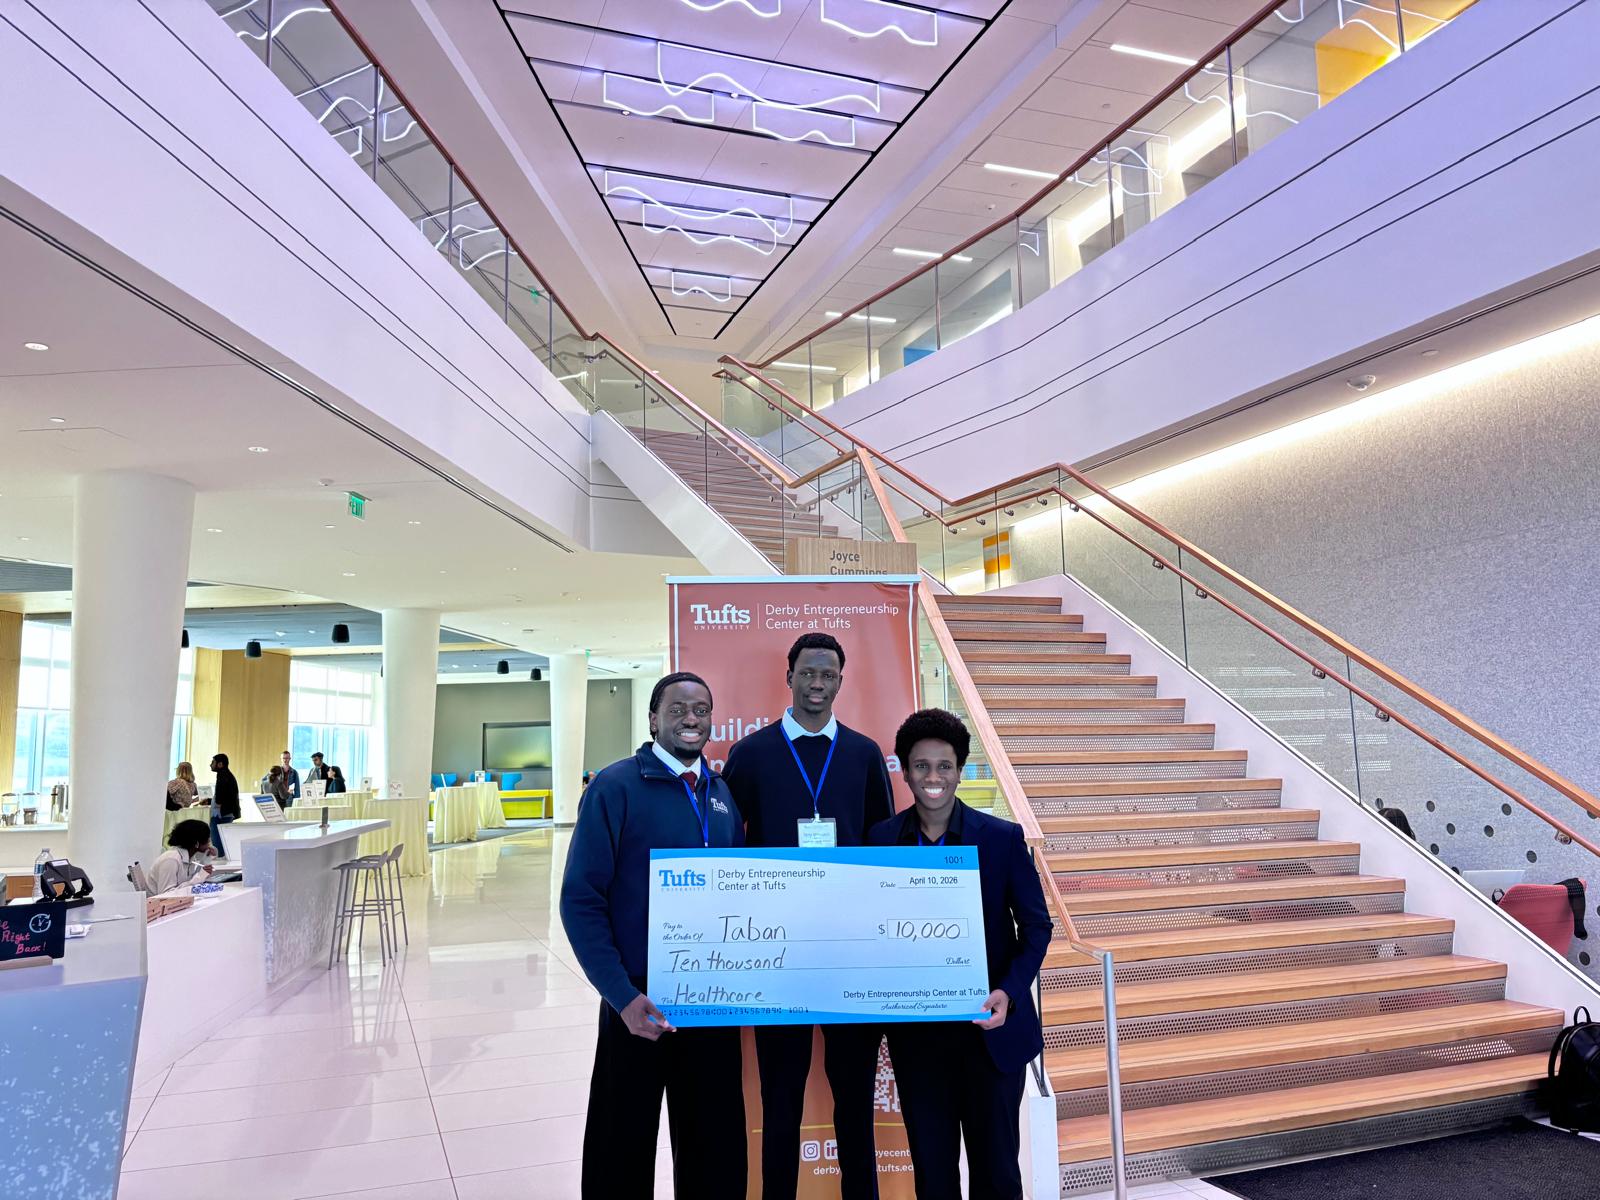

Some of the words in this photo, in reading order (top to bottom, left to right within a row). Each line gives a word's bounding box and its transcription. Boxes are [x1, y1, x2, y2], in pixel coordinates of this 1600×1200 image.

[830, 550, 860, 564] Joyce
[690, 603, 750, 624] Tufts
[766, 603, 800, 616] Derby
[804, 603, 899, 617] Entrepreneurship
[766, 619, 803, 629] Center
[808, 619, 818, 629] at
[822, 618, 851, 629] Tufts
[944, 856, 963, 864] 1001
[658, 869, 706, 887] Tufts
[718, 869, 745, 880] Derby
[748, 868, 825, 879] Entrepreneurship
[718, 881, 748, 890] Center
[751, 881, 760, 890] at
[763, 880, 786, 890] Tufts
[909, 876, 925, 885] April
[928, 877, 939, 885] 10,
[940, 876, 958, 884] 2026
[663, 922, 676, 932] Pay
[718, 915, 786, 942] Taban
[878, 924, 886, 935] $
[896, 921, 961, 942] 10,000
[1, 930, 30, 945] Right
[673, 932, 691, 940] Order
[693, 932, 704, 942] Of
[669, 949, 701, 973] Ten
[707, 947, 786, 970] thousand
[675, 982, 766, 1006] Healthcare
[843, 990, 866, 999] Derby
[867, 989, 931, 999] Entrepreneurship
[932, 988, 957, 997] Center
[959, 989, 967, 997] at
[968, 988, 987, 996] Tufts
[789, 1006, 809, 1014] 1001
[880, 1002, 918, 1010] Authorized
[917, 1002, 948, 1012] Signature
